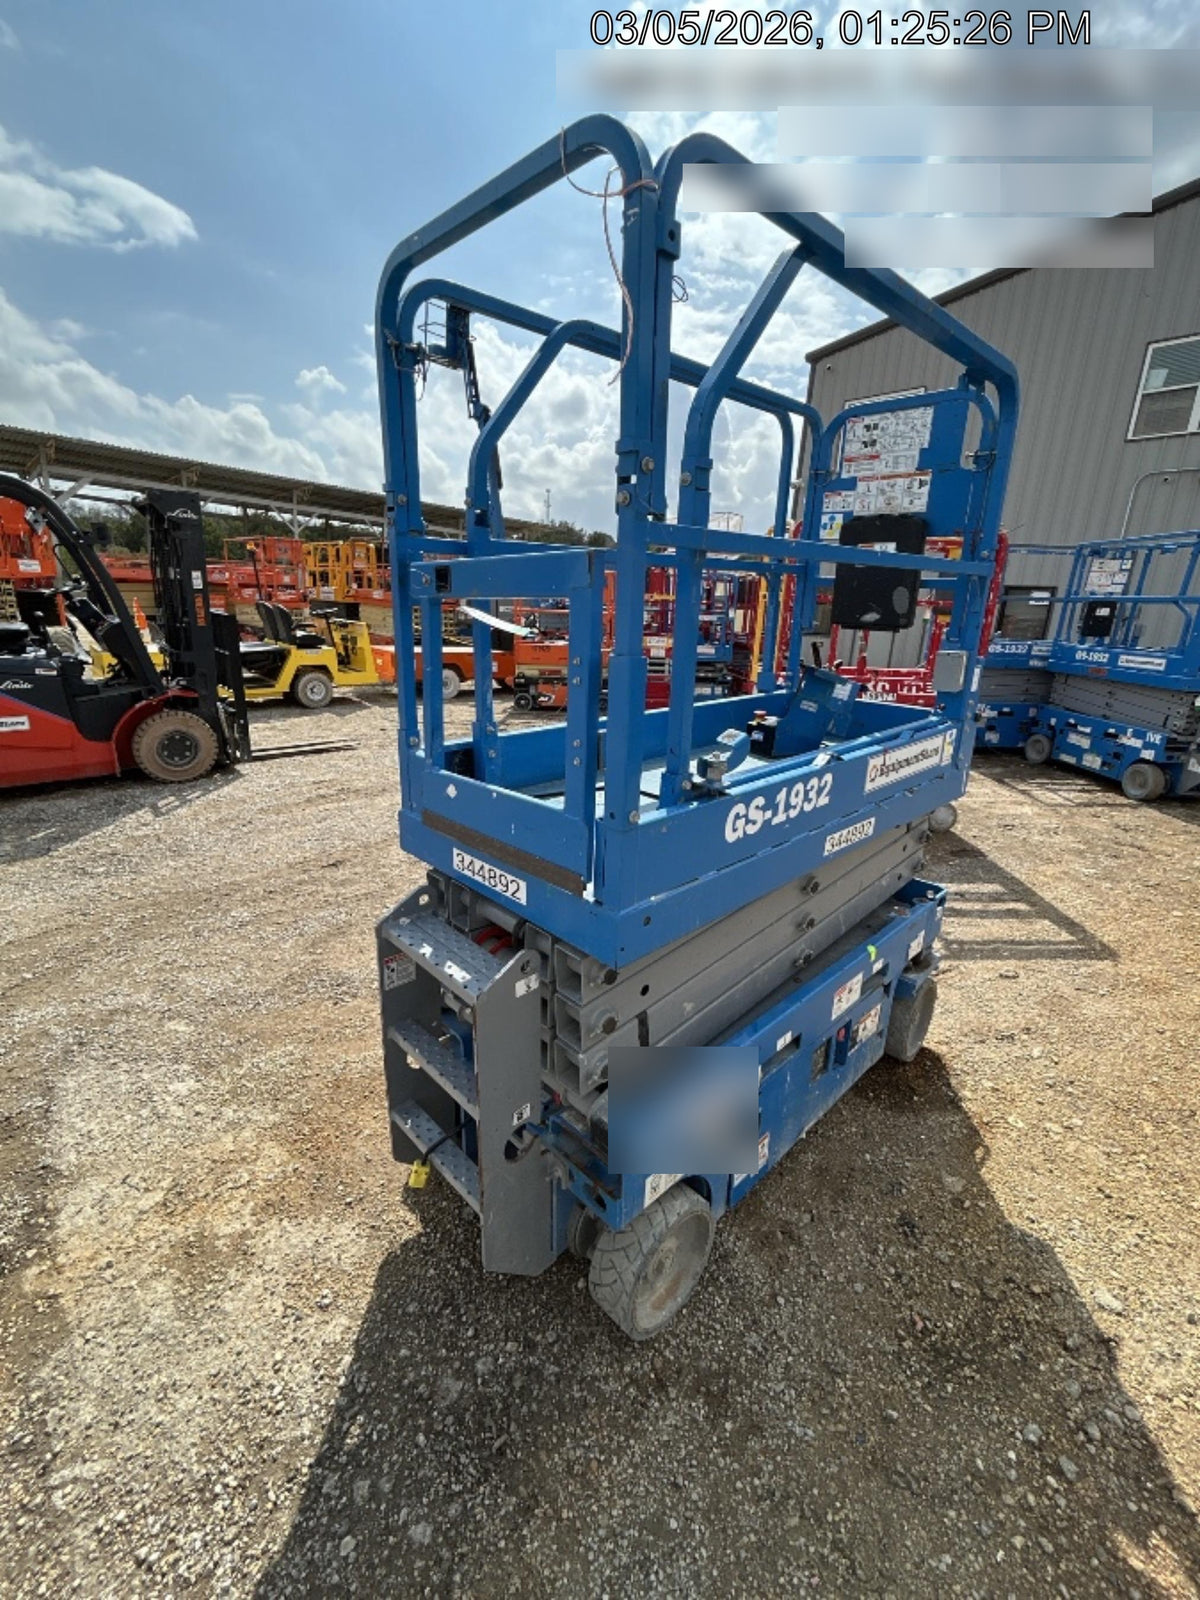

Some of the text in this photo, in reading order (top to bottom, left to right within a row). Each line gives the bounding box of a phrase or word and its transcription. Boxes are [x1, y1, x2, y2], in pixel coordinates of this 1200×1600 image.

[725, 773, 833, 843] GS-1932
[826, 820, 872, 853] 344892
[455, 852, 522, 902] 344892
